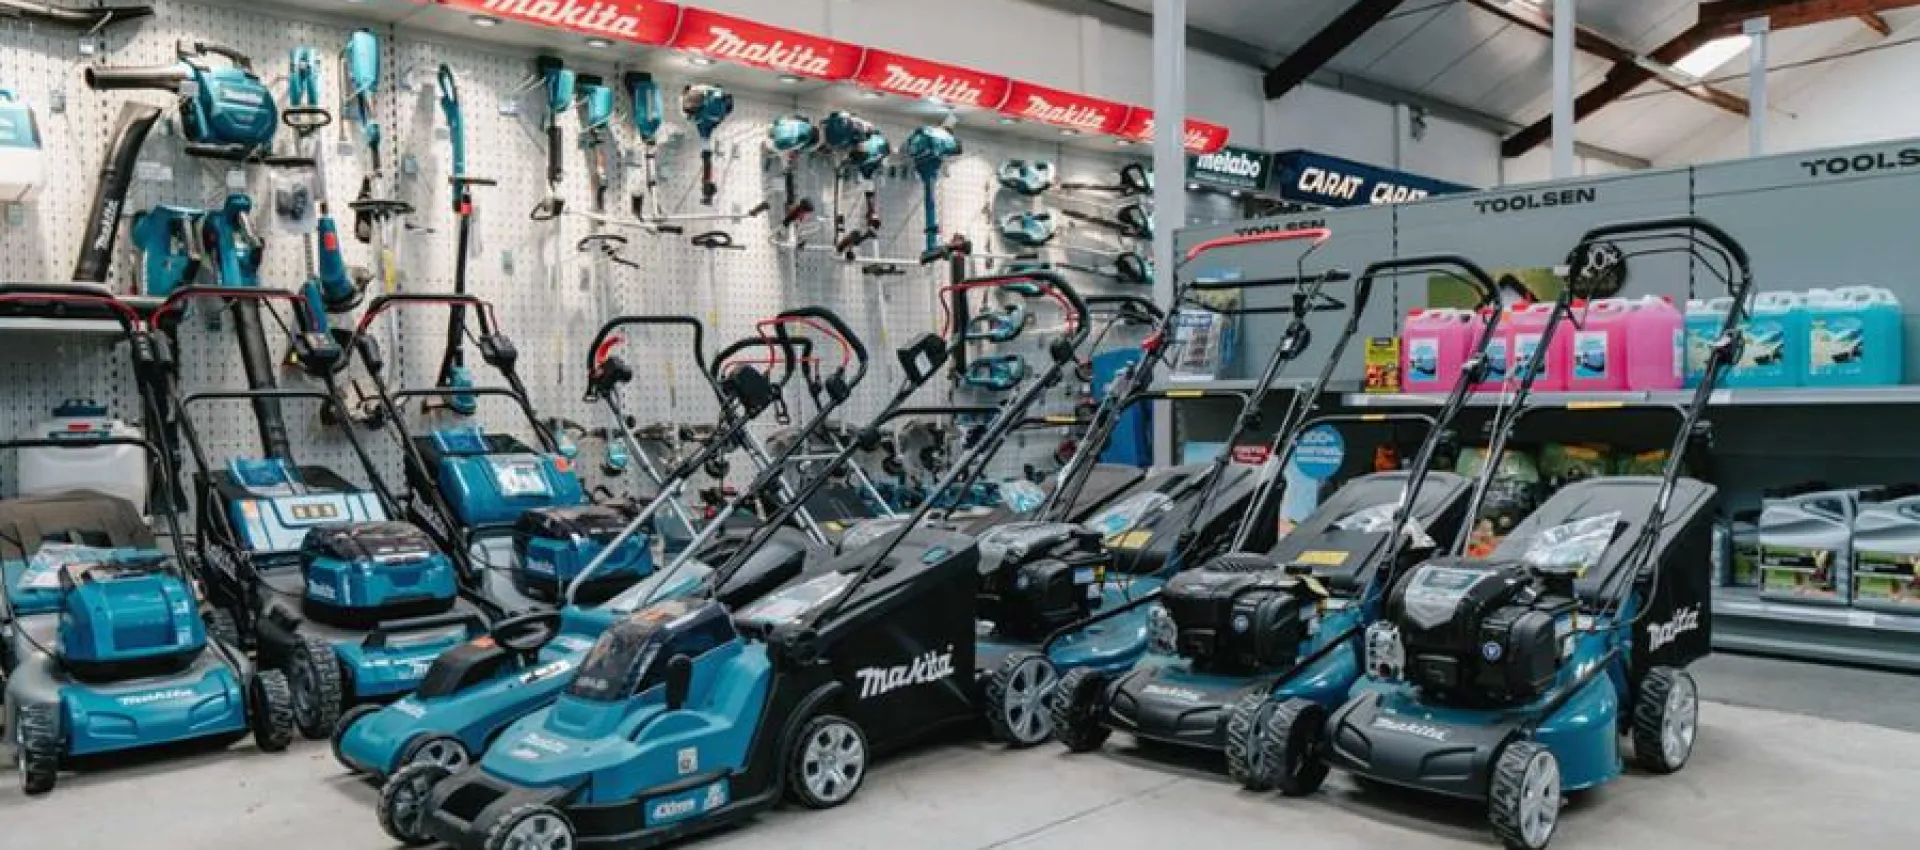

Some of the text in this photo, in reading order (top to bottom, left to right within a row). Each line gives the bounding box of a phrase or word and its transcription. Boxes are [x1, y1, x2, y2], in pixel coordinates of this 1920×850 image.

[708, 27, 830, 75] Makita
[881, 64, 983, 105] Makita
[1024, 95, 1107, 129] Makita
[1298, 166, 1365, 201] CARAT
[1474, 187, 1596, 215] TOOLSEN
[855, 643, 955, 699] Makita
